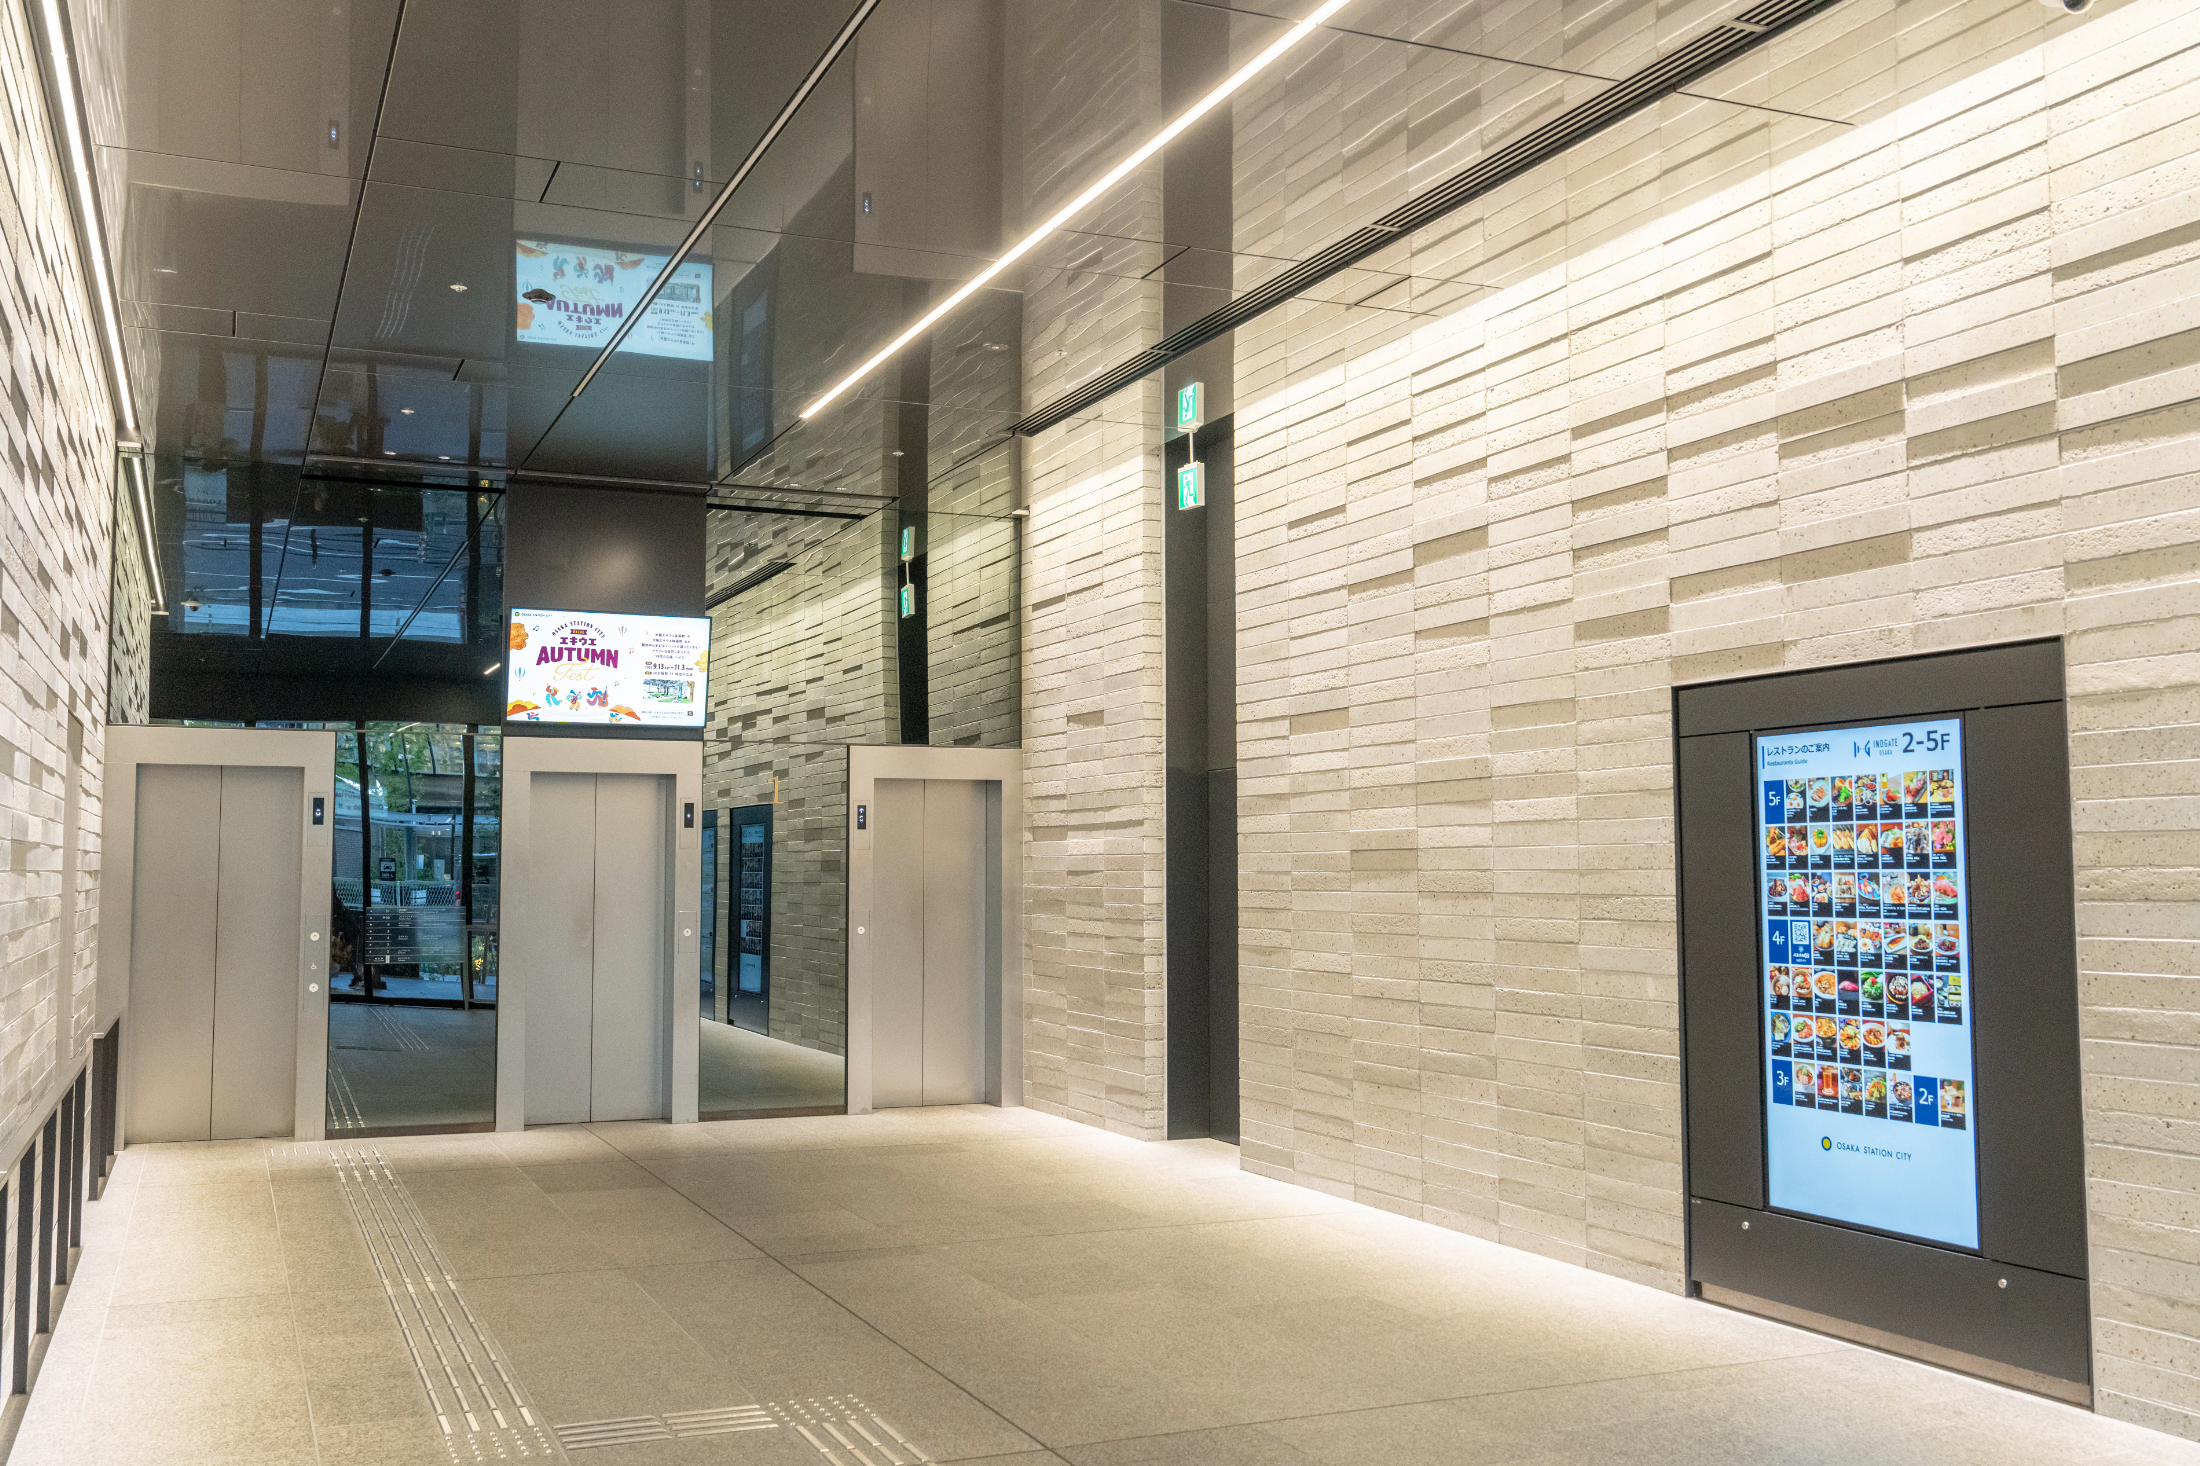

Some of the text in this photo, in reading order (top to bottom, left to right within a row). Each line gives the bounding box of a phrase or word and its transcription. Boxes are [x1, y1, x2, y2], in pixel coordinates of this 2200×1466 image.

[569, 620, 593, 629] STATION
[560, 636, 597, 646] エキウエ
[536, 646, 619, 669] AUTUMN
[553, 657, 600, 681] Fest
[1767, 742, 1830, 756] レストランのご案内
[1873, 738, 1898, 748] INOGATE
[1902, 730, 1950, 753] 2-5F
[1767, 759, 1793, 767] Restaurants
[767, 775, 784, 804] 1
[1768, 791, 1781, 806] 5F
[1772, 930, 1785, 945] 4F
[1776, 1070, 1789, 1086] 3F
[1918, 1088, 1934, 1105] 2F
[1836, 1141, 1912, 1161] OSAKA STATION CITY
